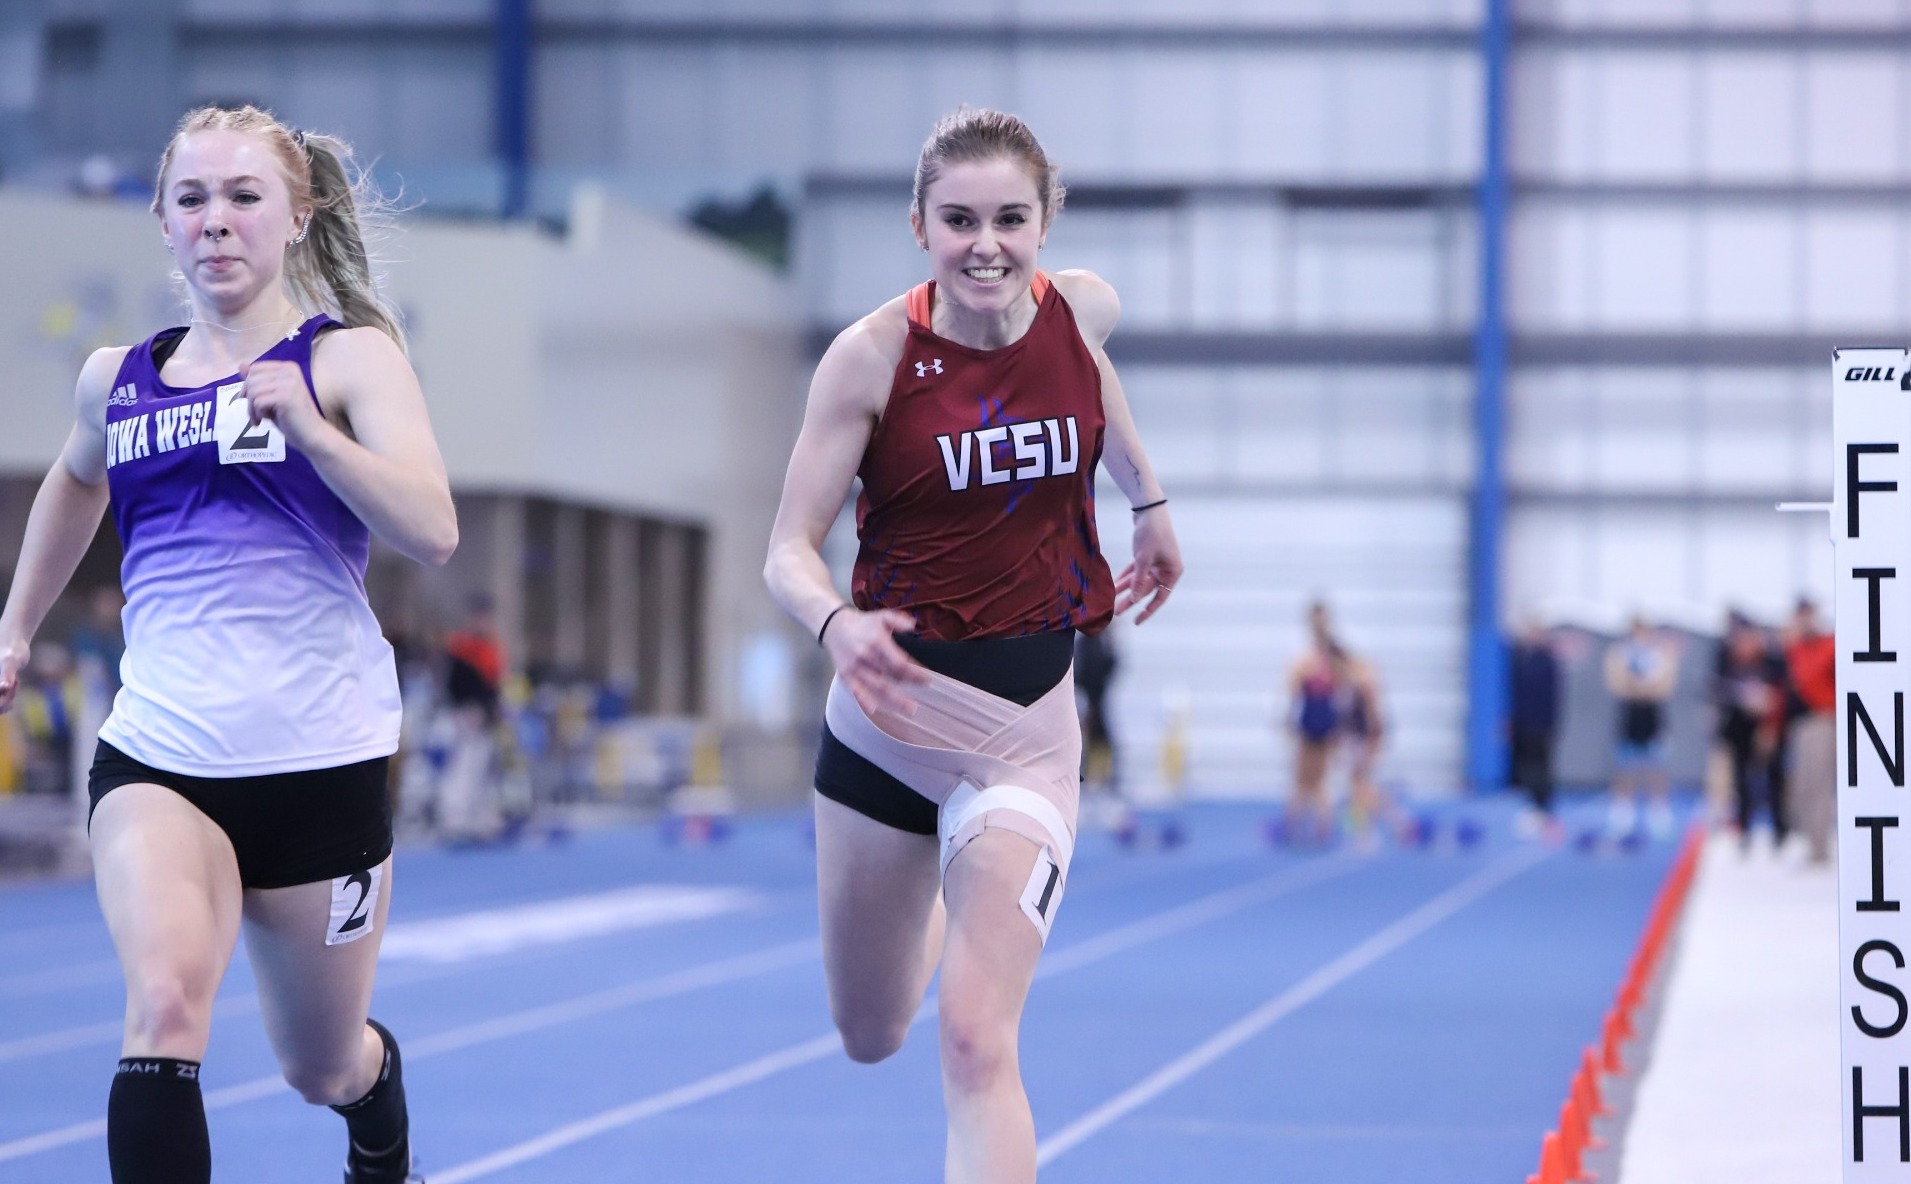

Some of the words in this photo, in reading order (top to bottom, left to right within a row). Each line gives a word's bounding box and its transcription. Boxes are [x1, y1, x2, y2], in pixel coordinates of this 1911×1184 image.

[107, 397, 139, 407] adidas
[1844, 367, 1895, 381] GILL
[106, 413, 151, 470] IOWA
[935, 415, 1079, 492] VCSU
[1846, 442, 1911, 1163] FINISH
[337, 869, 372, 933] 2
[1031, 860, 1060, 926] 1
